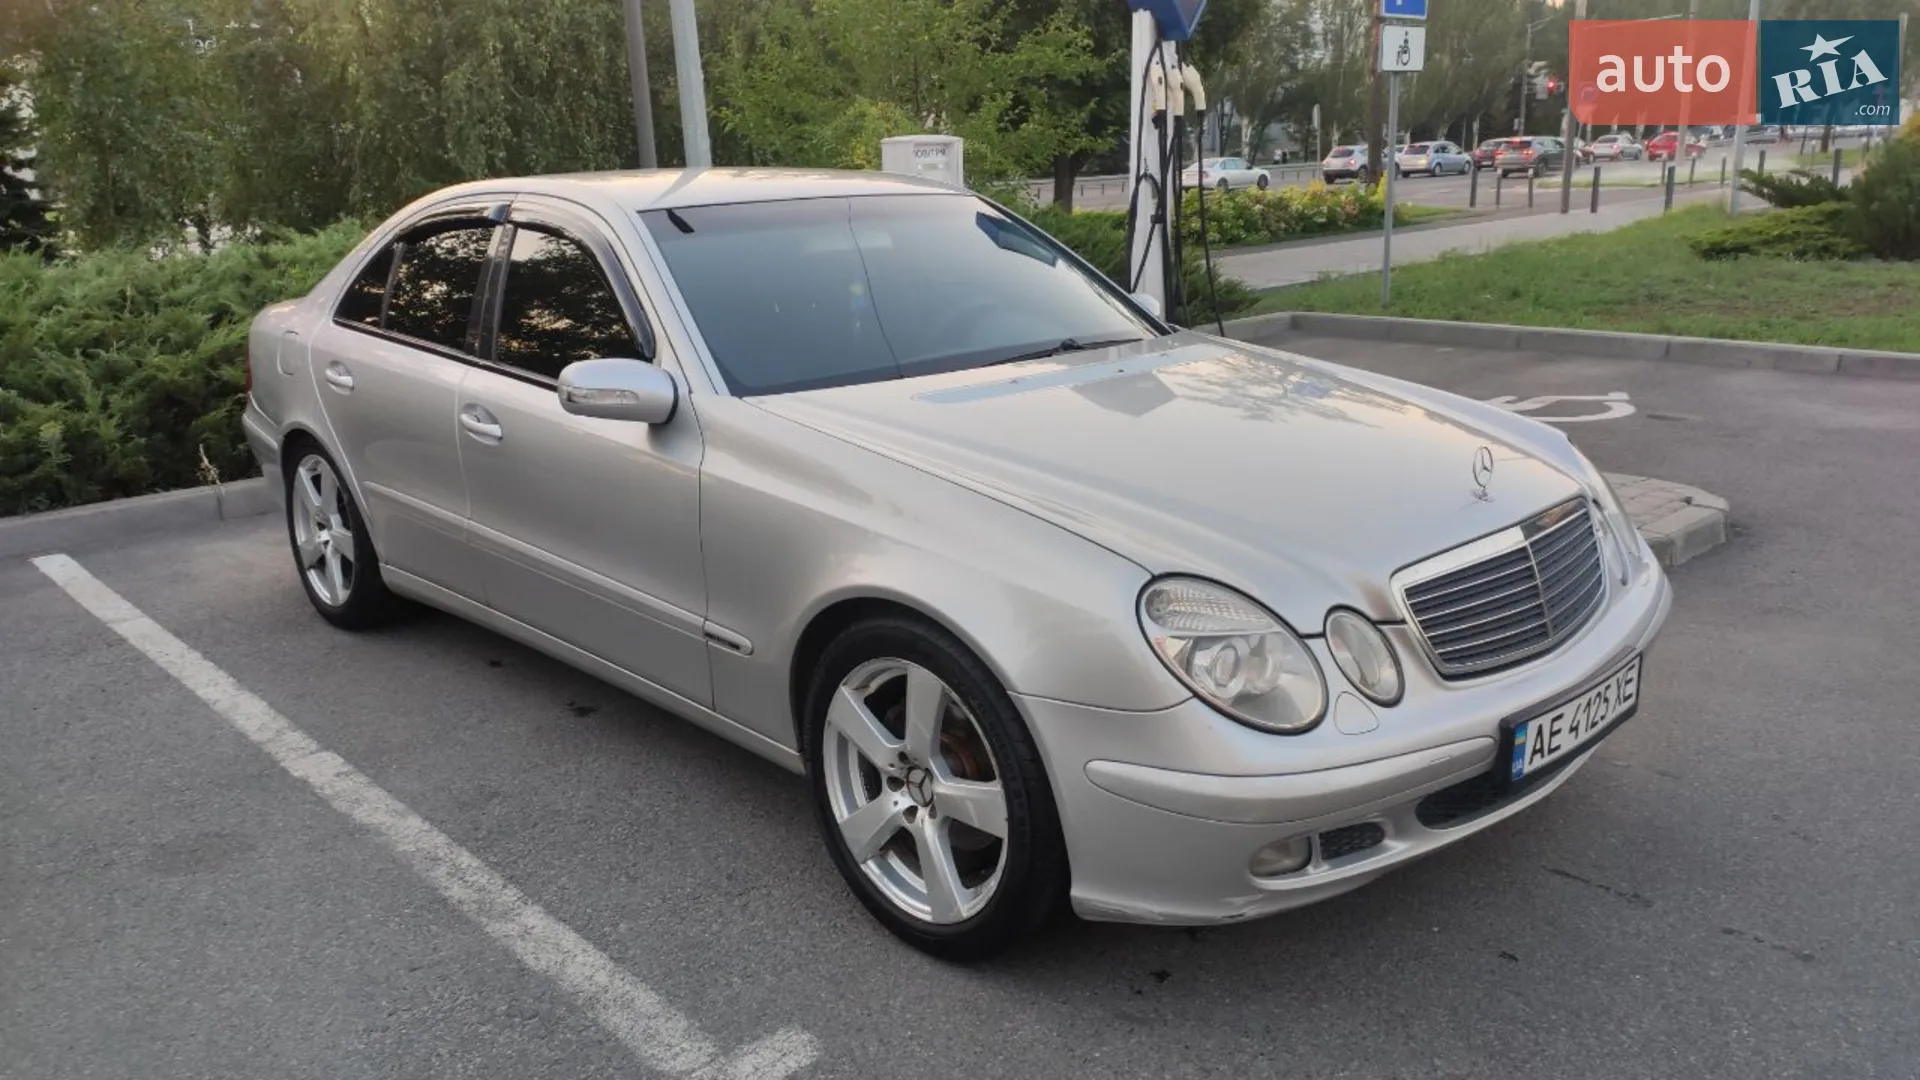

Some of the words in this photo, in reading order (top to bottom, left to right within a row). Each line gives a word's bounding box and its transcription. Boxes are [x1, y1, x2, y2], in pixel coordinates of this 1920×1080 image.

[1529, 712, 1564, 765] AE
[1568, 684, 1611, 740] 4125
[1612, 663, 1636, 713] XE
